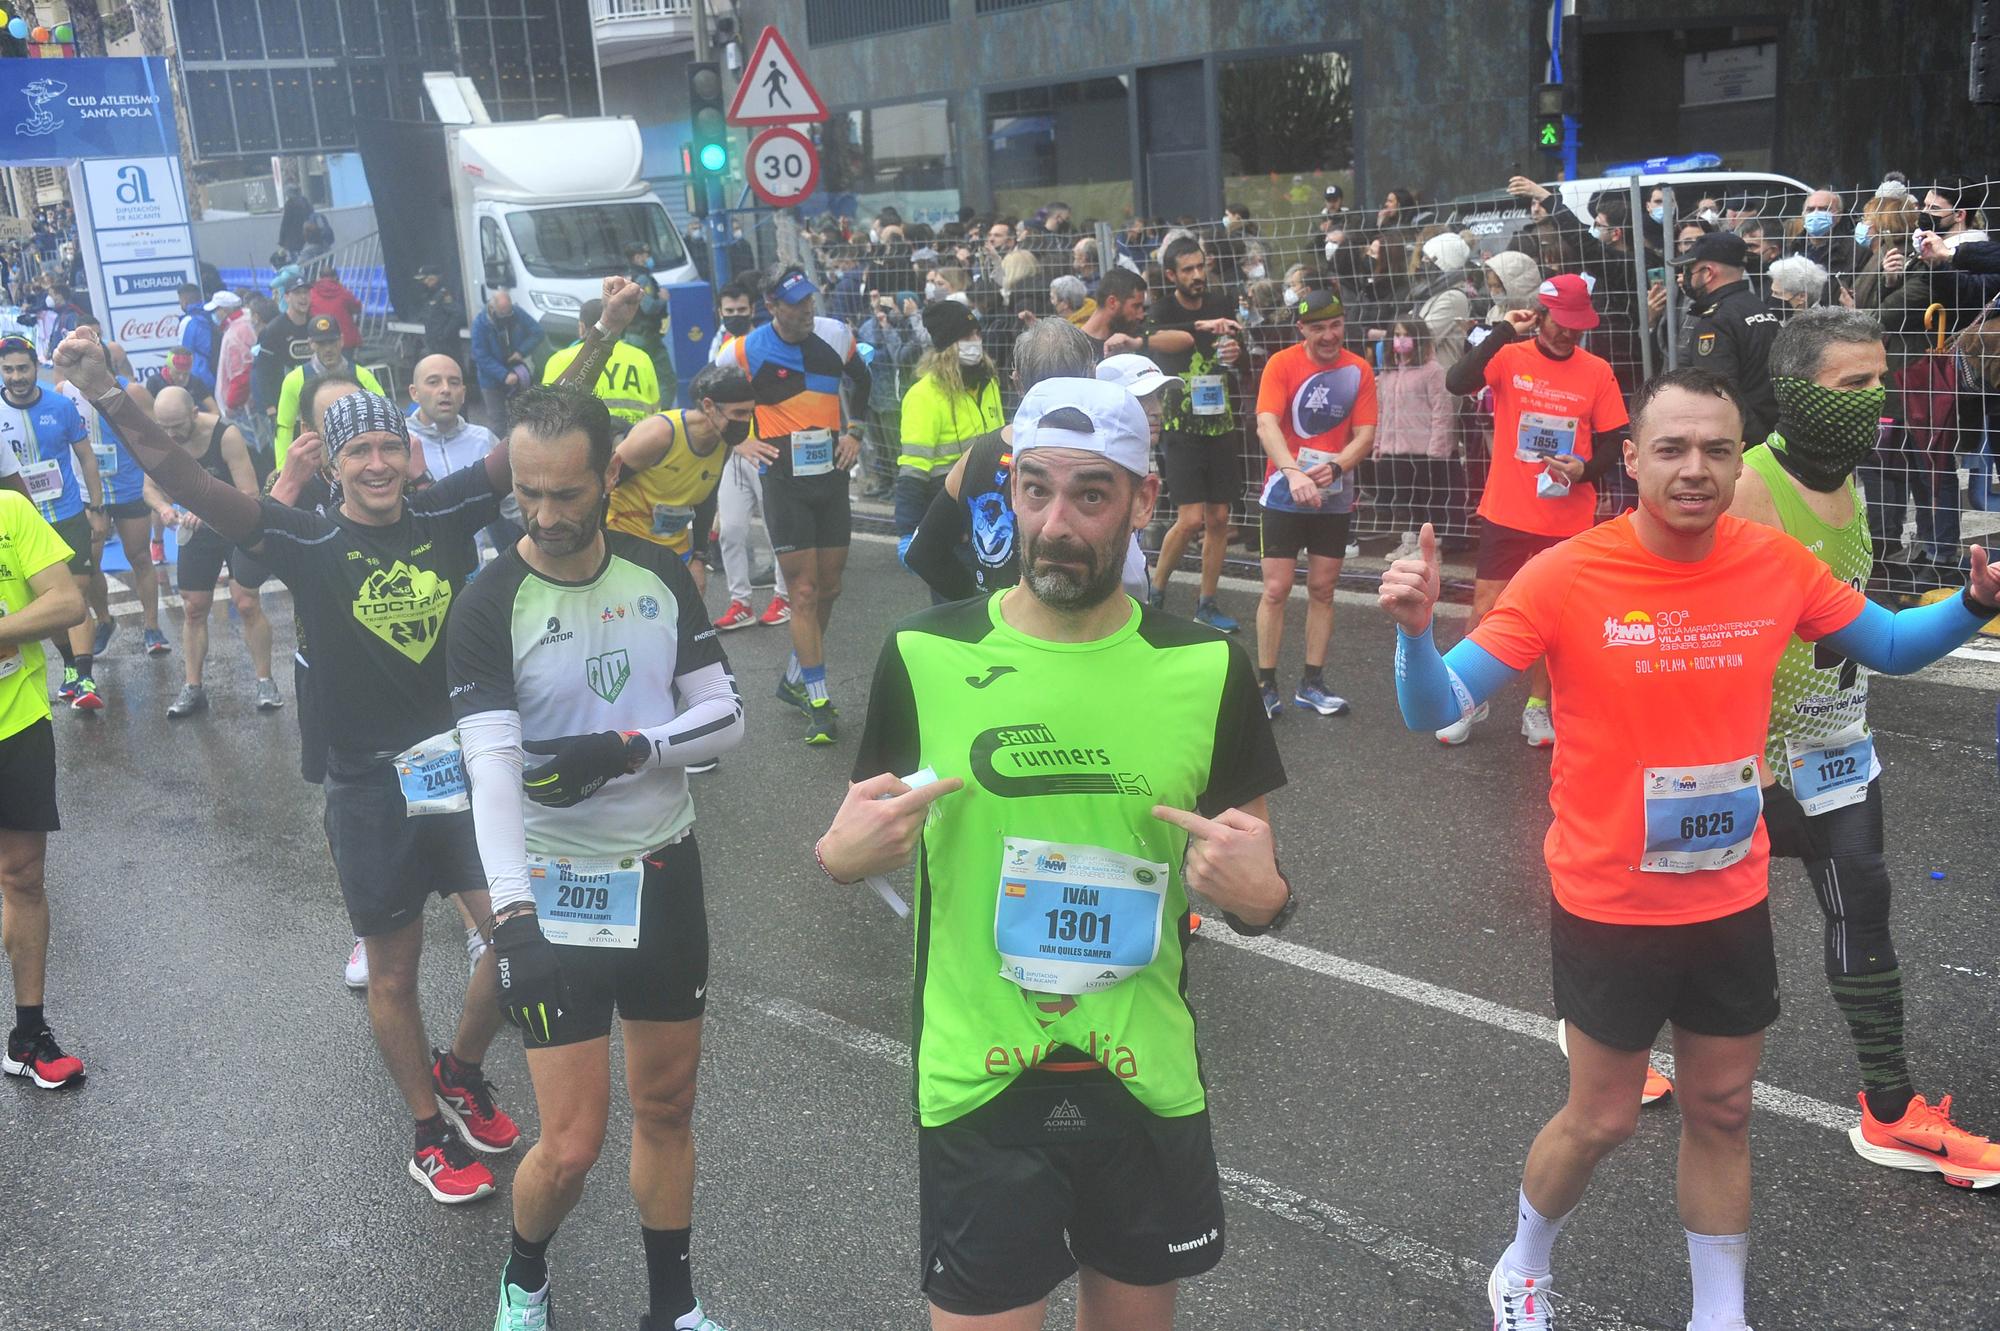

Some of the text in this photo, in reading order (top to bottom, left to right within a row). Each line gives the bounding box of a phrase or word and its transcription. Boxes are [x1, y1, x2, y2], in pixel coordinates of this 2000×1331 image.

[67, 95, 160, 107] CLUB ATLETISMO
[80, 107, 153, 119] SANTA POLA
[763, 154, 802, 180] 30
[1462, 208, 1527, 224] GUARDIA CIVIL
[121, 315, 180, 341] Coca-Col
[135, 366, 162, 383] JO
[602, 363, 642, 394] YA
[1533, 436, 1559, 450] 1855
[1657, 618, 1776, 636] MITJA MARATÓ INTERNACIONAL
[1658, 628, 1759, 643] VILA DE SANTA POLA
[540, 631, 574, 646] VIATOR
[1660, 643, 1671, 651] 23
[1702, 640, 1722, 648] 2022
[1635, 660, 1653, 674] SOL
[1660, 658, 1687, 673] PLAYA
[1794, 694, 1867, 717] Virgen del Alc
[997, 723, 1054, 746] sanvi
[1010, 749, 1111, 768] runners
[423, 765, 463, 792] 2443
[1818, 756, 1856, 782] 1122
[1681, 811, 1734, 840] 6825
[557, 885, 608, 910] 2079
[1063, 886, 1099, 906] IVÁN
[1045, 909, 1111, 944] 1301
[1039, 943, 1112, 959] IVÁN QUILES SAMPER
[985, 1031, 1138, 1079] evlia
[1168, 1233, 1208, 1253] luanvi
